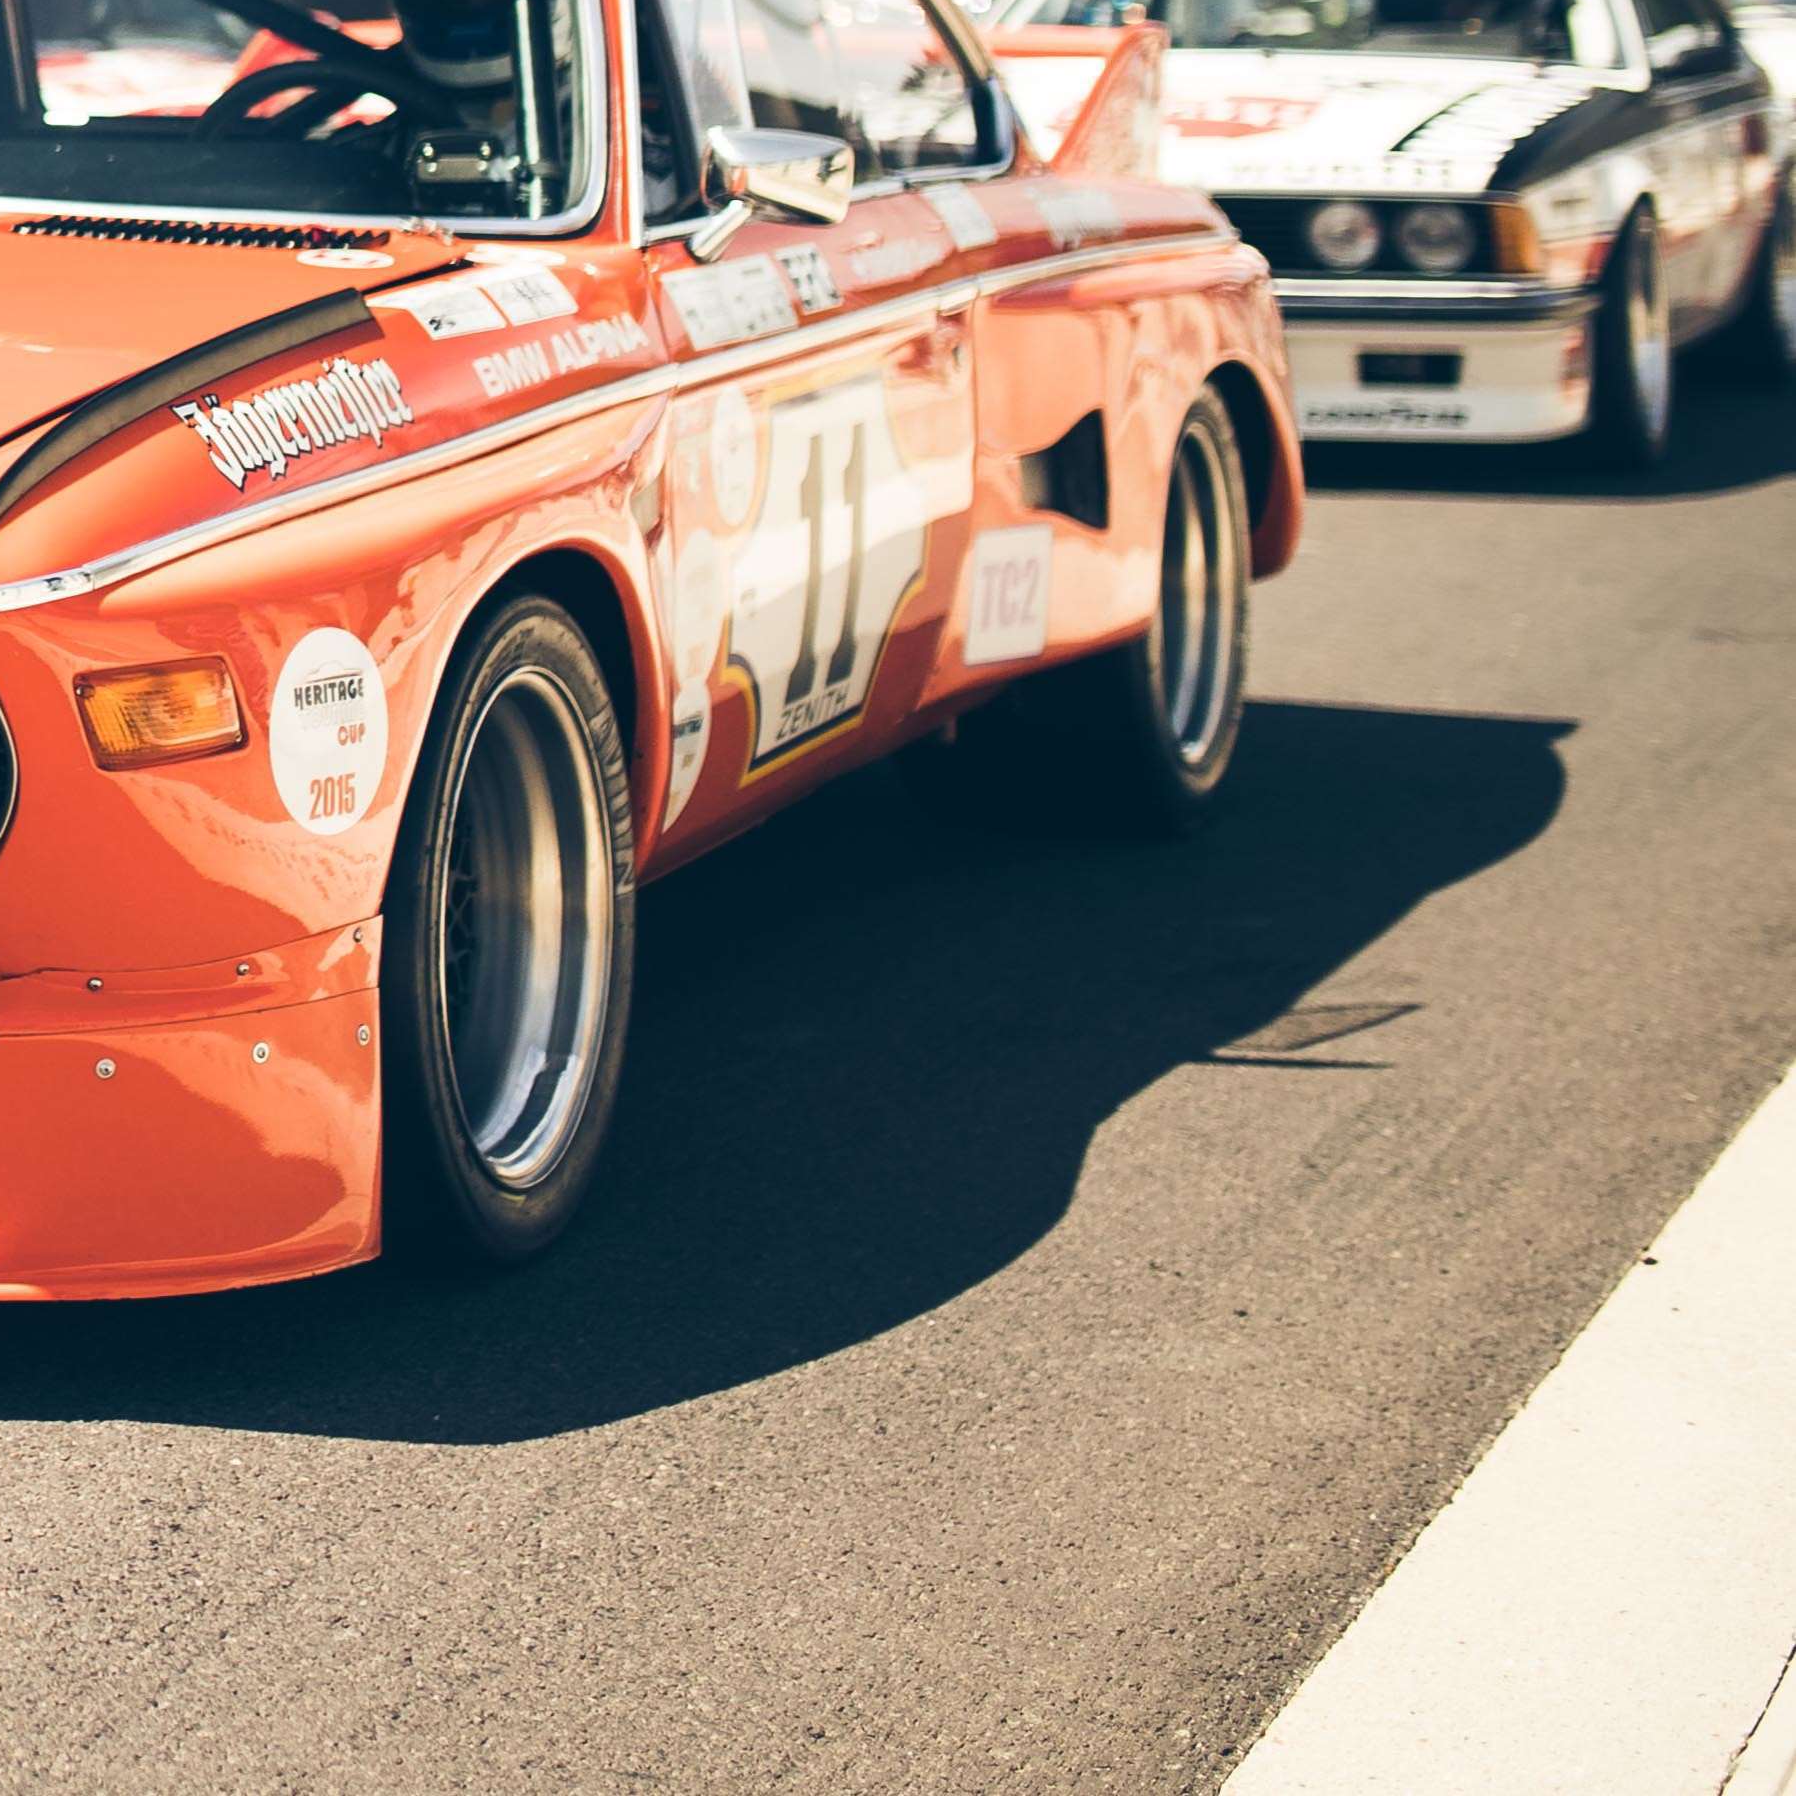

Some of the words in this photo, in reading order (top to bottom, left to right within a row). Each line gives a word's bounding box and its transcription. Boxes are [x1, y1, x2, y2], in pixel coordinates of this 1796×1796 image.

[472, 340, 552, 398] BMW
[550, 311, 649, 375] ALPINA
[785, 423, 864, 704] 11
[982, 558, 1039, 630] TC2
[294, 678, 365, 710] HERITAGE
[775, 682, 851, 740] ZENITH
[337, 722, 367, 746] CUP
[309, 772, 357, 820] 2015
